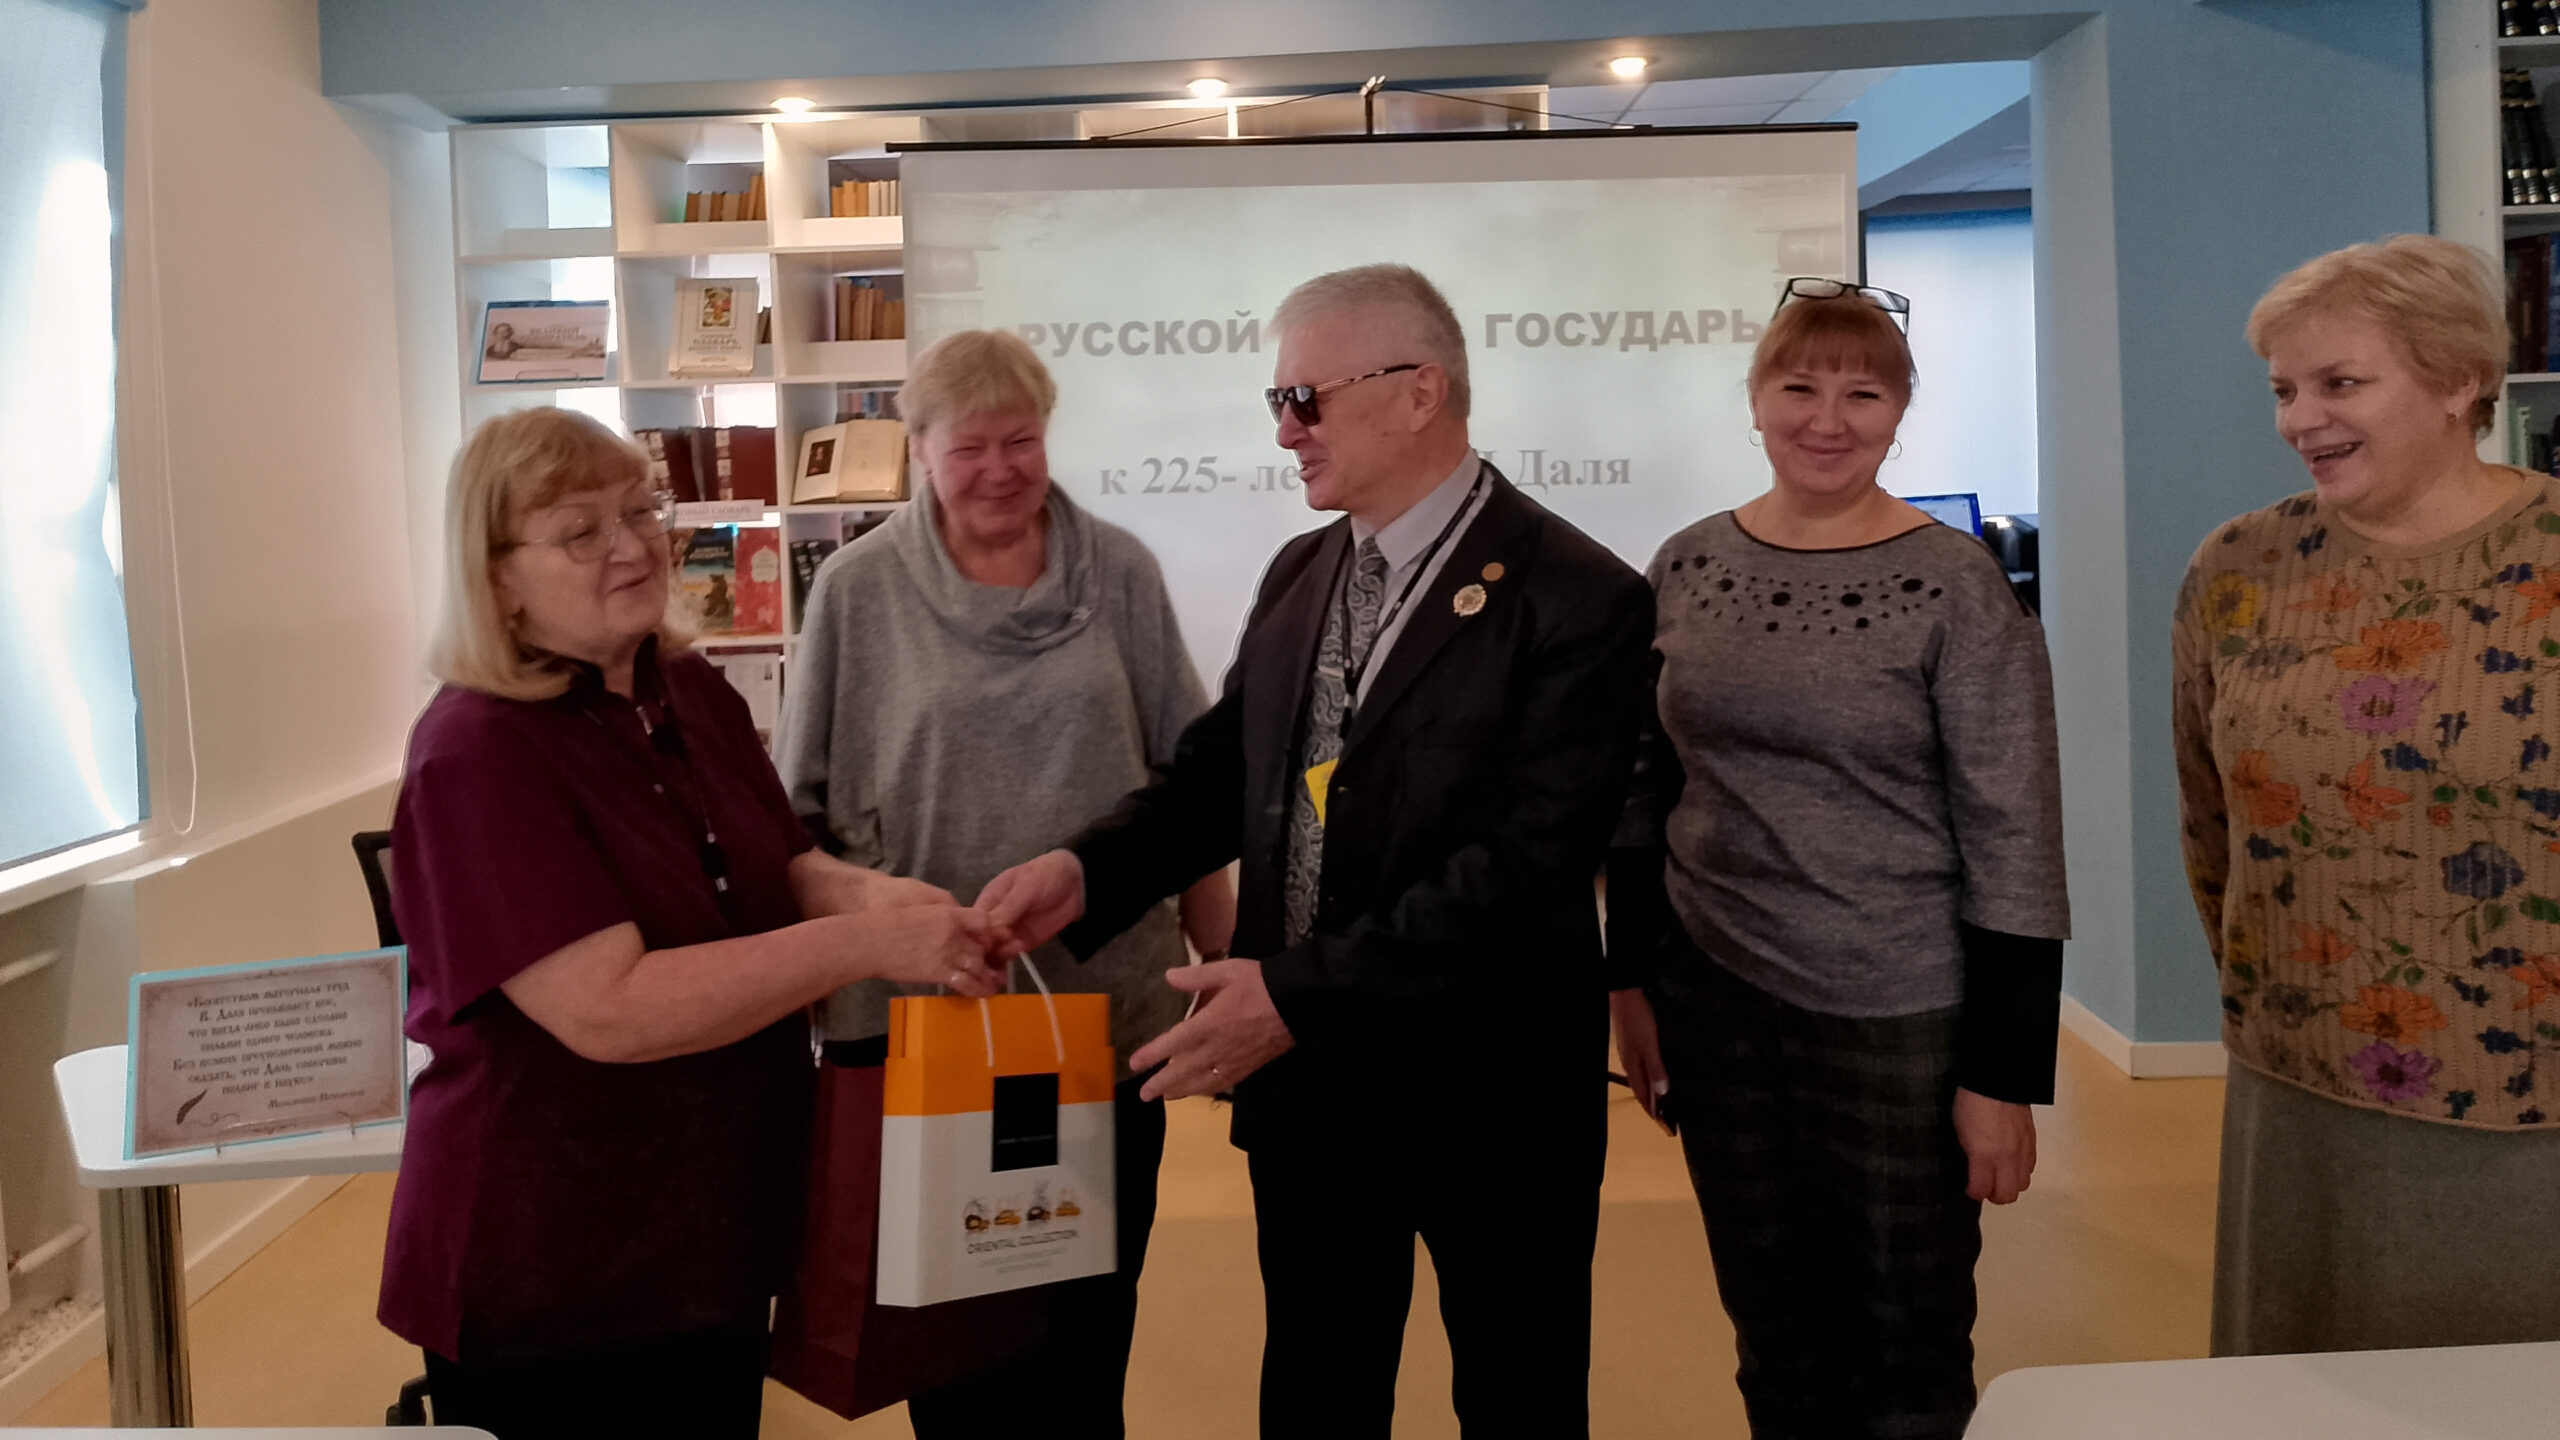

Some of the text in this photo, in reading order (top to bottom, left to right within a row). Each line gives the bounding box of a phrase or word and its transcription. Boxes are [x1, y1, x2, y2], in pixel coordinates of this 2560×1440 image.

[1019, 310, 1260, 357] РУССКОЙ
[1485, 309, 1765, 352] ГОСУДАРЬ
[1100, 469, 1127, 494] к
[1513, 449, 1631, 495] Даля
[966, 1229, 1079, 1255] ORIENTAL COLLECTION
